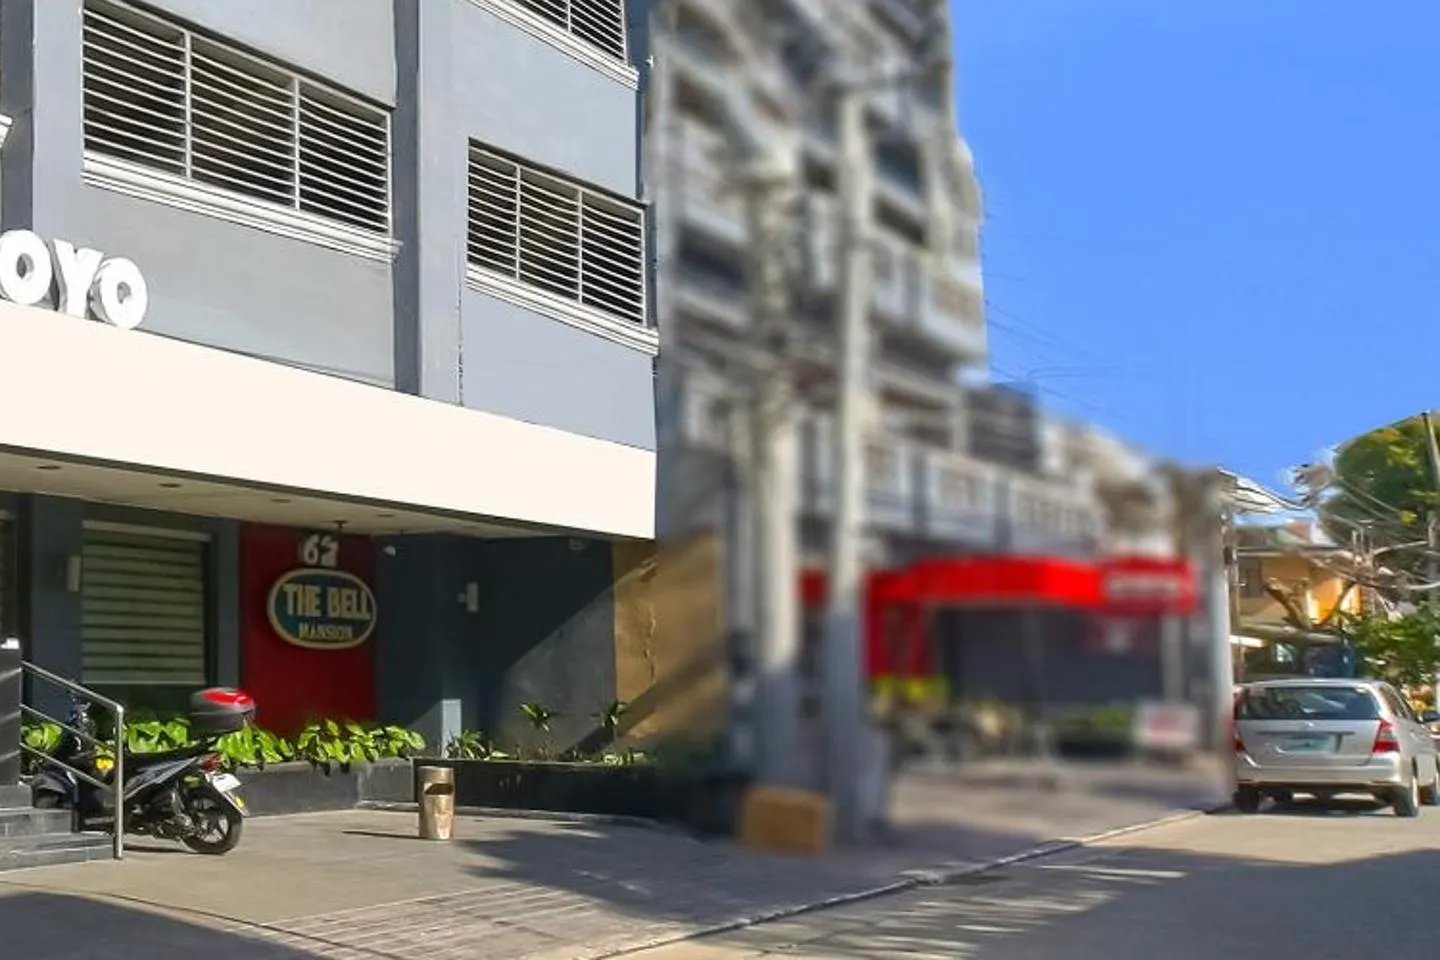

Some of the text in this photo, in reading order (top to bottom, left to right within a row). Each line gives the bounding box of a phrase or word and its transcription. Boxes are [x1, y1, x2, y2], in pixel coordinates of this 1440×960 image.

[282, 583, 372, 620] THE BELL
[298, 621, 353, 640] MANSION
